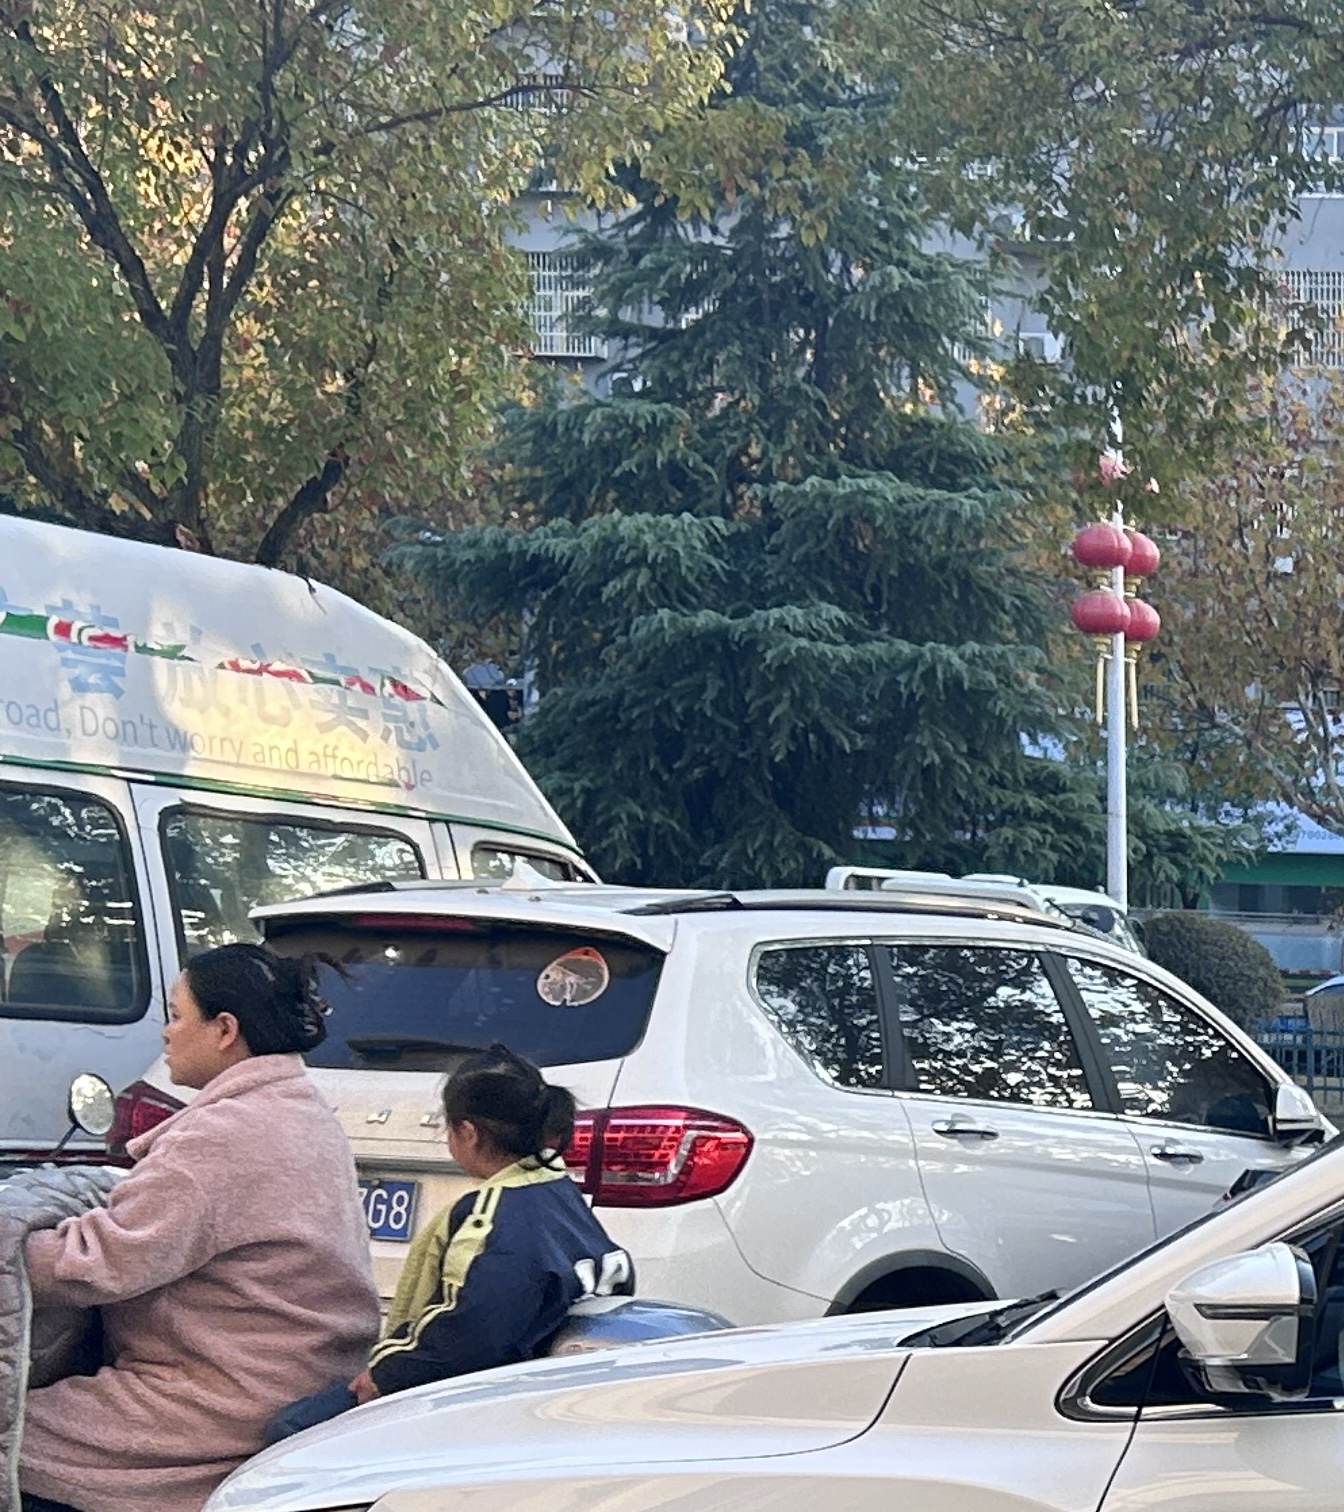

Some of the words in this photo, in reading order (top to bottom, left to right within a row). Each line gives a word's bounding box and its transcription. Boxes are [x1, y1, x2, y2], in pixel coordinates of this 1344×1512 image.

[0, 697, 72, 739] oad,
[79, 704, 158, 748] Don't
[164, 726, 244, 764] worry
[252, 738, 299, 770] and
[308, 743, 433, 789] affordable
